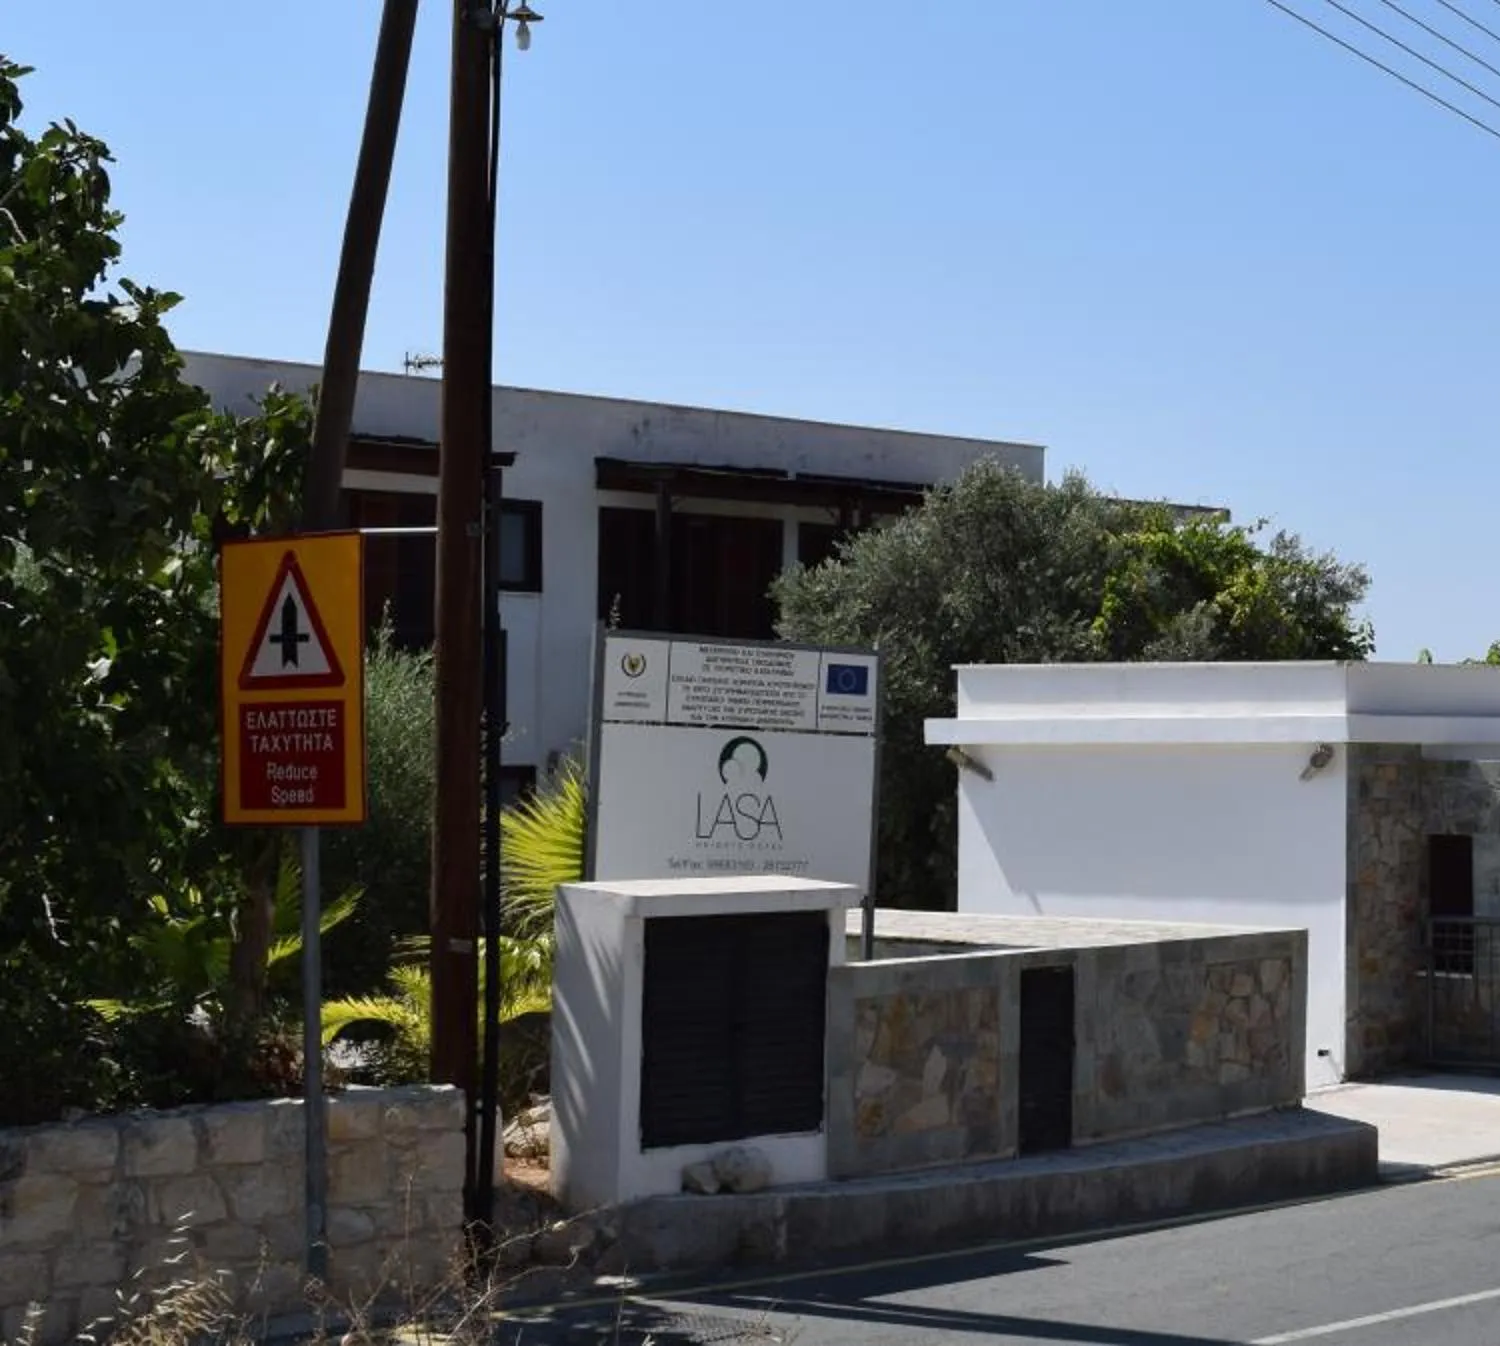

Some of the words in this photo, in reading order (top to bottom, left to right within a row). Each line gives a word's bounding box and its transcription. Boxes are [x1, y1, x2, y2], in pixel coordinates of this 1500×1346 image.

[246, 708, 337, 729] ΕΛΑΤΤΩΣΤΕ
[249, 733, 335, 753] ΤΑΧΥΤΗΤΑ
[266, 761, 319, 780] Reduce
[271, 784, 316, 805] Speed
[695, 792, 783, 841] LASA
